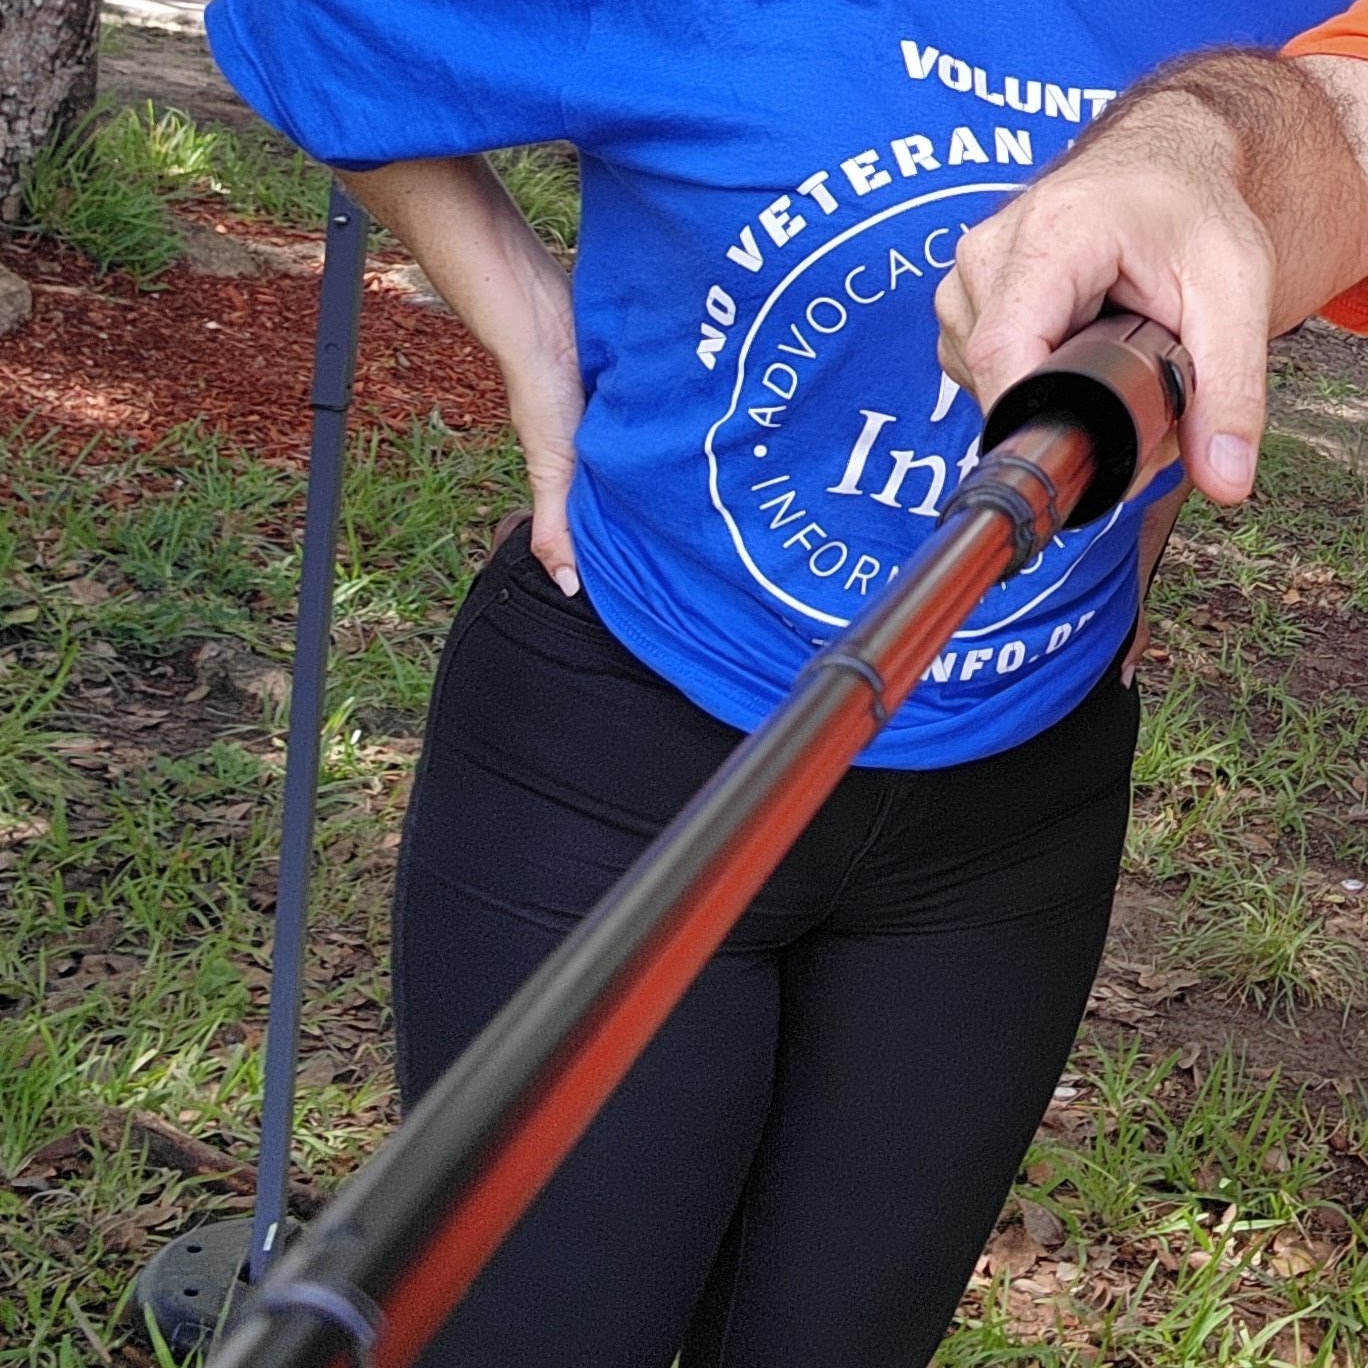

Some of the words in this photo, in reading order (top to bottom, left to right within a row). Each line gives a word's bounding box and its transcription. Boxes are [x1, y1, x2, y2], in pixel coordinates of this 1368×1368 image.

[901, 39, 1124, 123] VOLUNT
[696, 285, 737, 370] NO
[726, 127, 1034, 273] VETERAN
[748, 223, 969, 428] ADVOCAC
